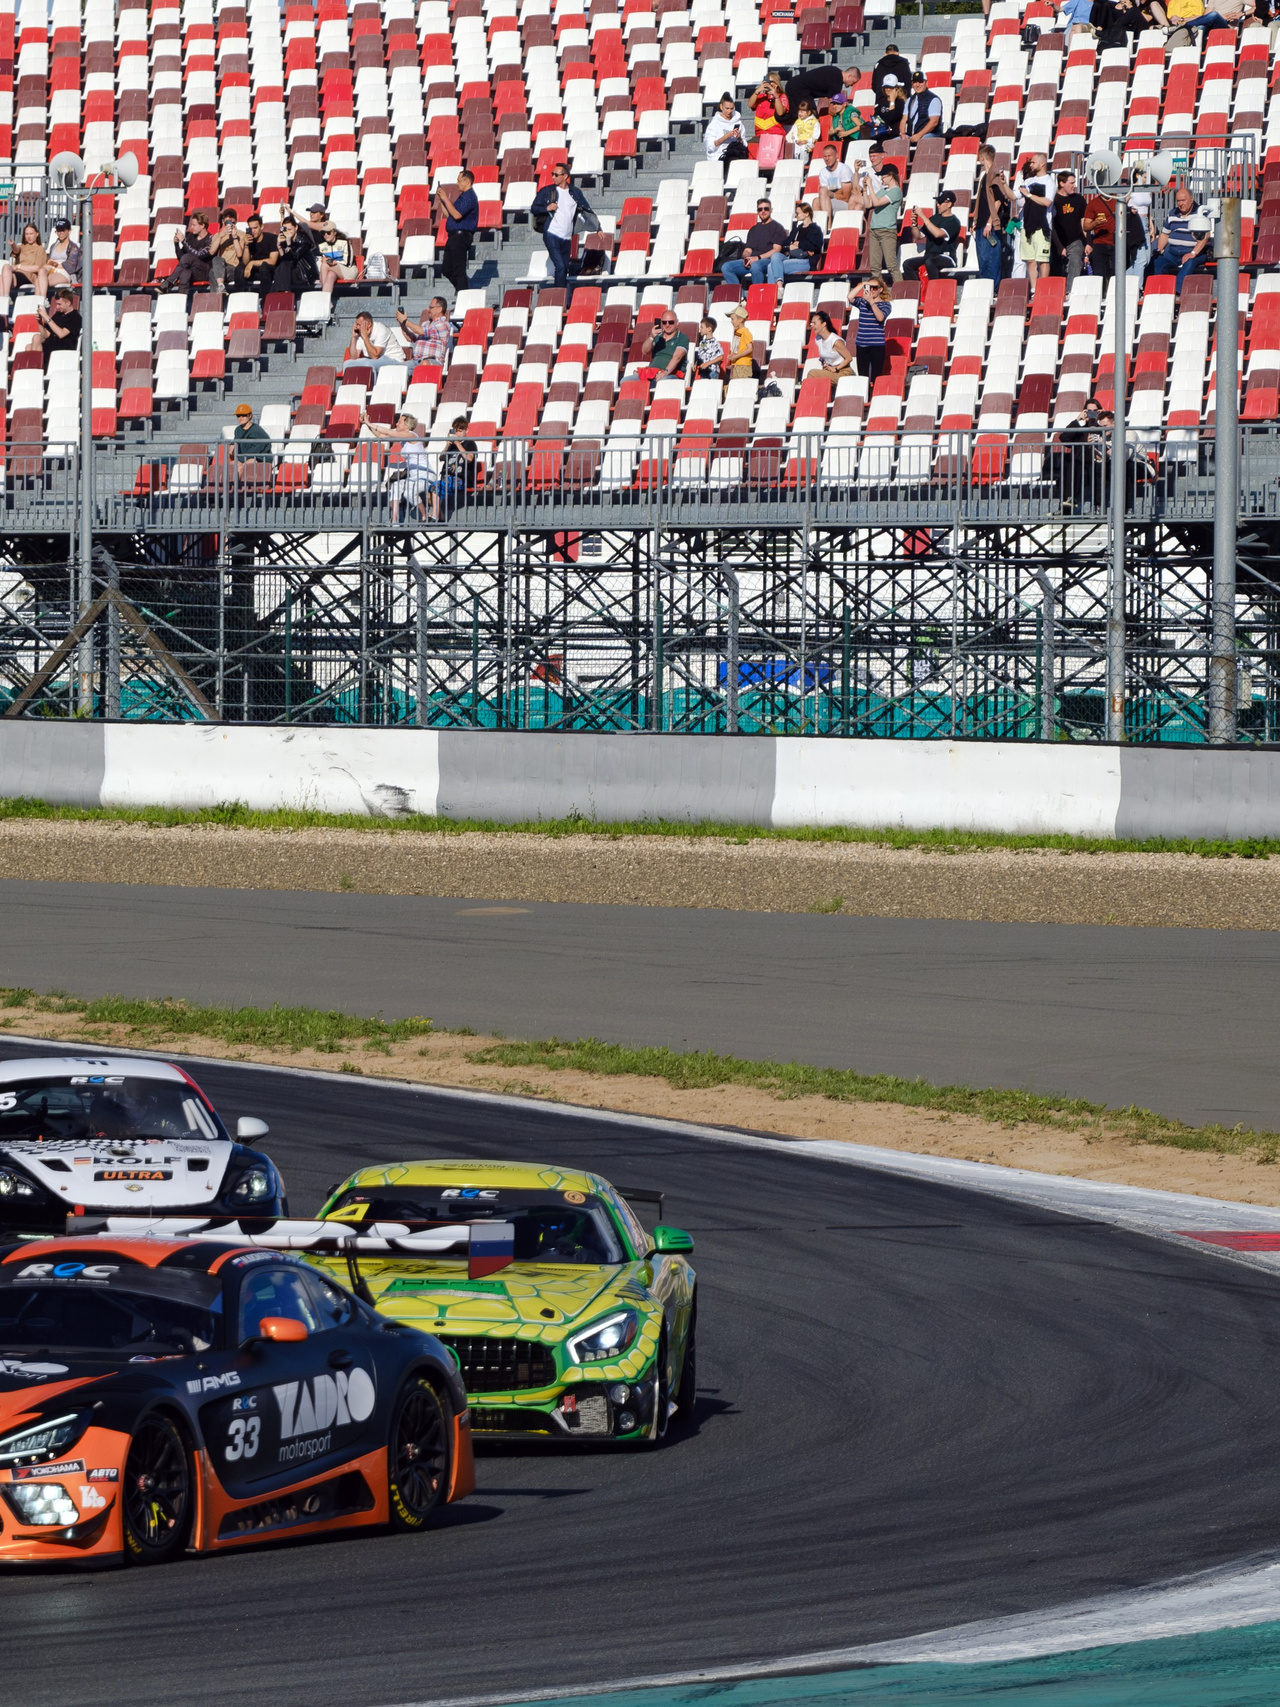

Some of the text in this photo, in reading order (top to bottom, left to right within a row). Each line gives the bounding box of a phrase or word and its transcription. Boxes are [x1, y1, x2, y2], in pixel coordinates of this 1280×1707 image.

[92, 1156, 182, 1165] ROLF
[103, 1170, 165, 1180] ULTRA
[324, 1203, 370, 1223] 4
[202, 1371, 242, 1392] AMG
[272, 1367, 376, 1439] YADRO
[225, 1416, 261, 1461] 33
[279, 1430, 332, 1462] motorsport
[30, 1462, 80, 1475] YOKOHAMA
